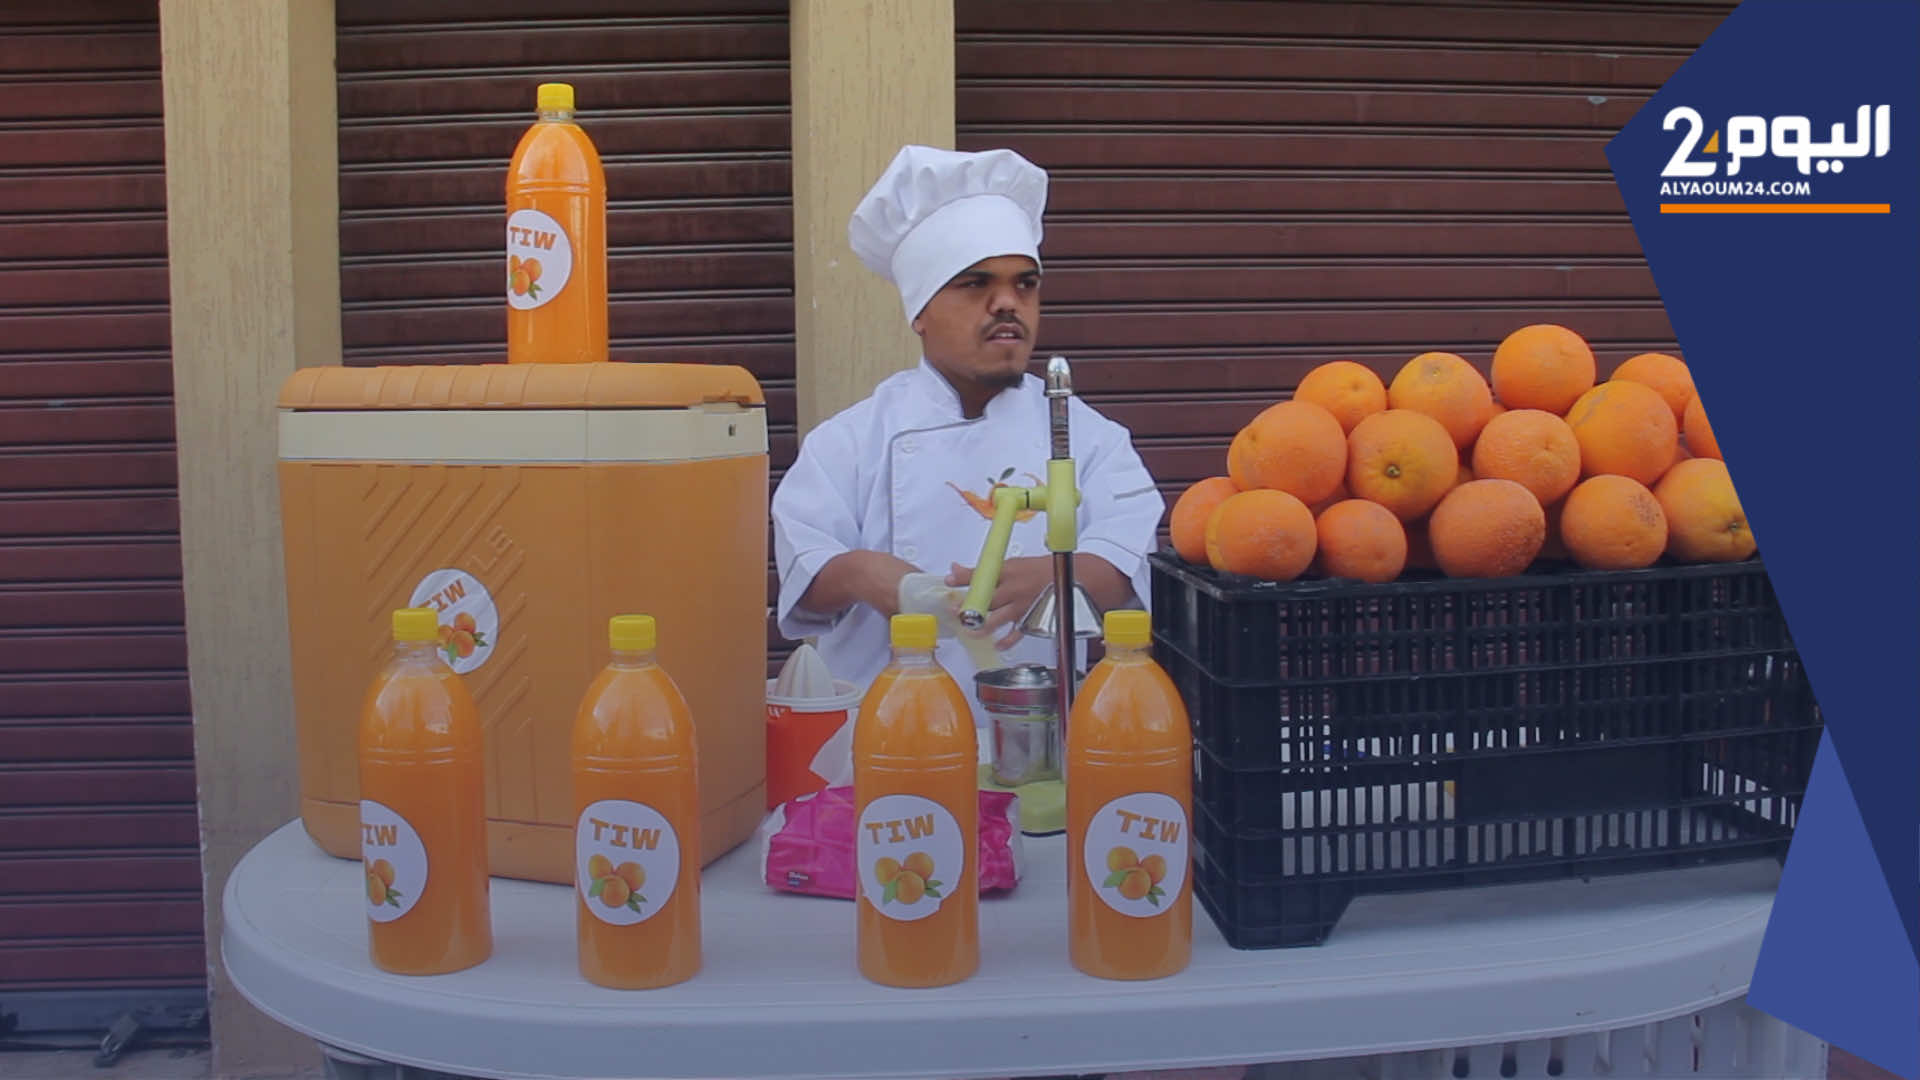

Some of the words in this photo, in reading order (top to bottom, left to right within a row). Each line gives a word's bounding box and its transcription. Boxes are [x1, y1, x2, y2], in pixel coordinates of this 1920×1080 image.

[509, 226, 557, 251] TIW
[361, 825, 398, 847] IW
[589, 817, 662, 850] TIW
[865, 813, 934, 845] TIW
[1116, 809, 1181, 844] TIW
